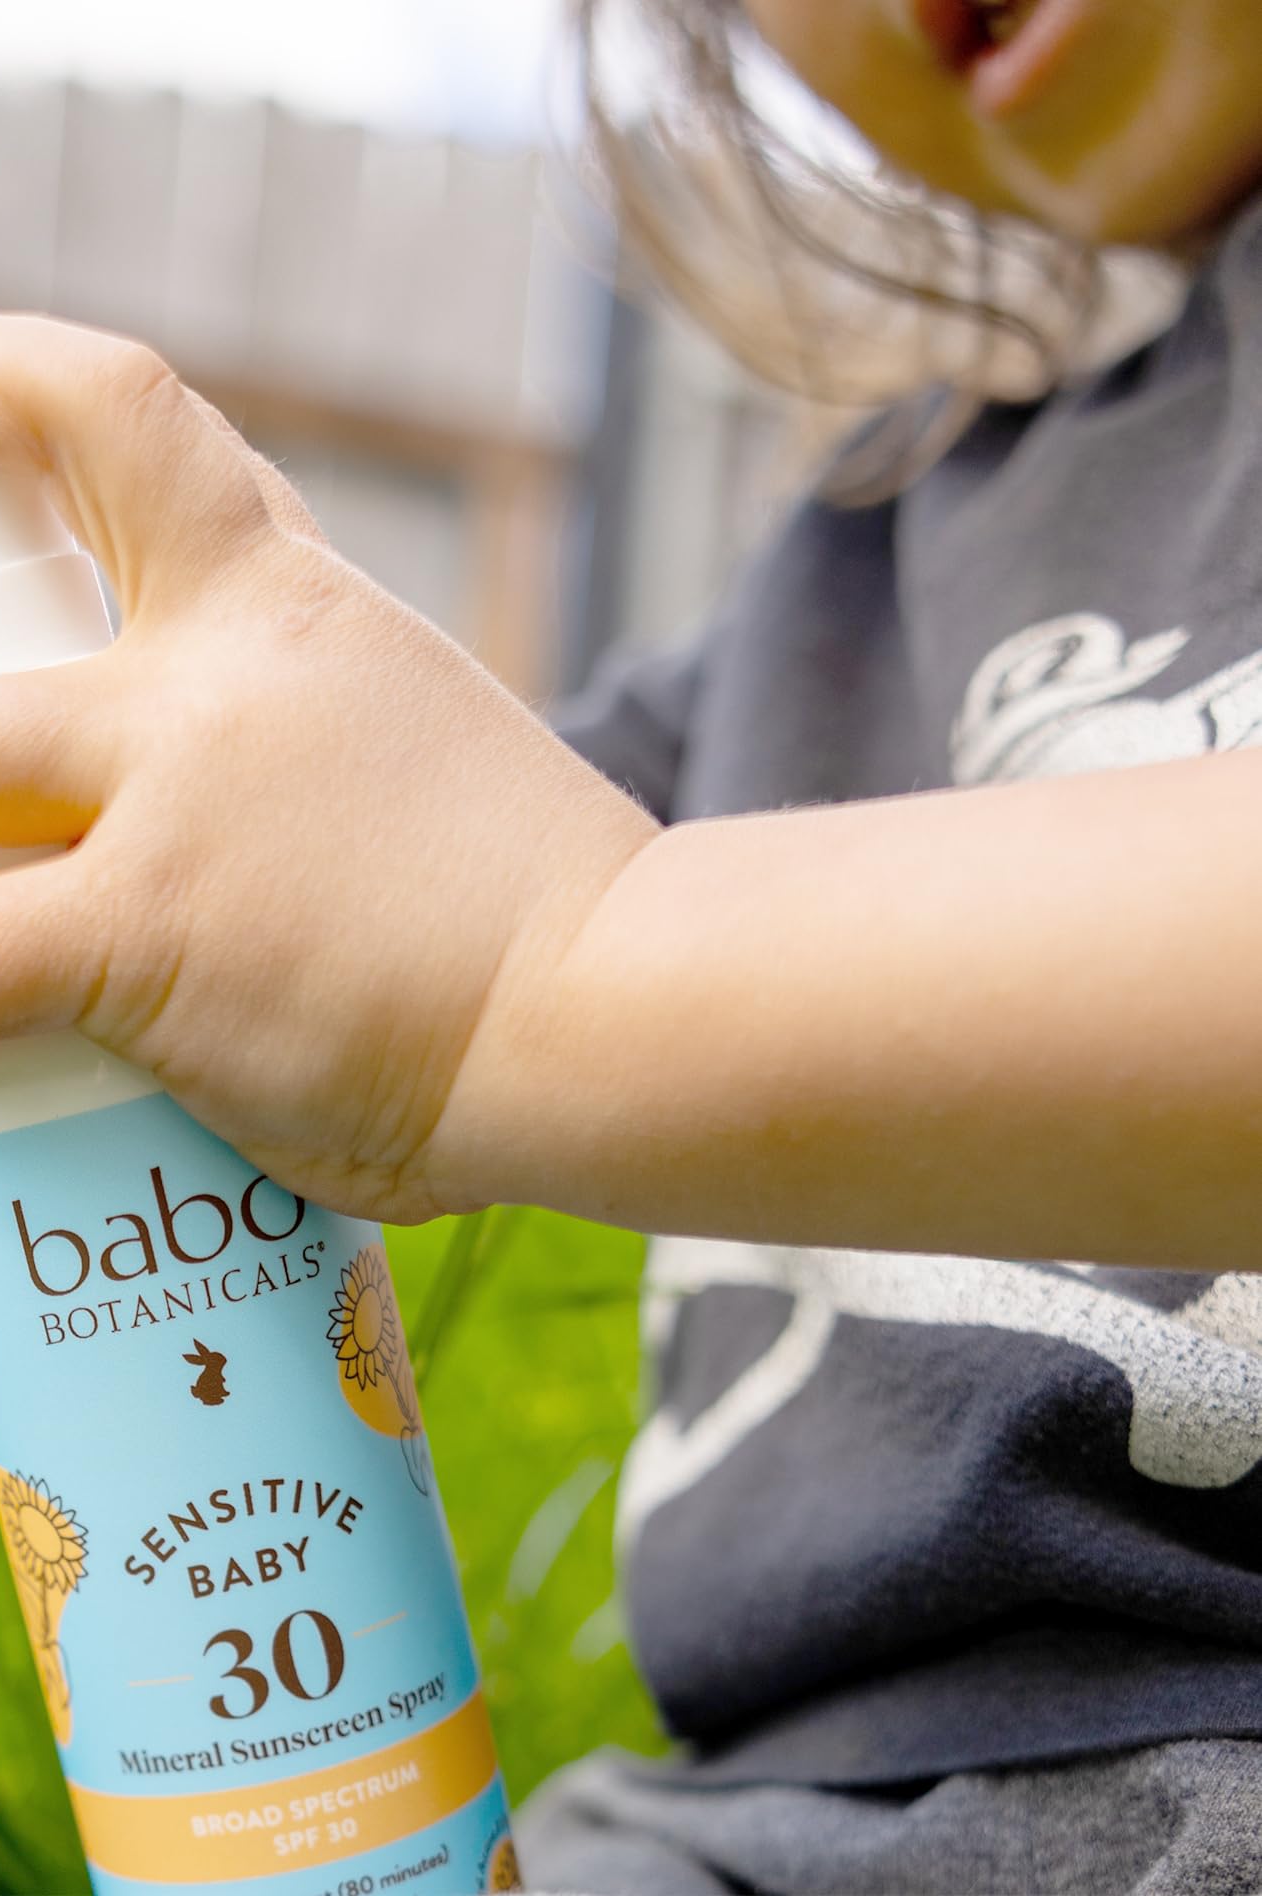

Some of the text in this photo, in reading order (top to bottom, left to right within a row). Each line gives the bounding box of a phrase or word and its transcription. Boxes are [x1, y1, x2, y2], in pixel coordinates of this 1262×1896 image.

[12, 1166, 305, 1296] babo
[124, 1478, 364, 1585] SENSITIVE
[187, 1536, 310, 1599] BABY
[202, 1609, 345, 1719] 30
[119, 1671, 446, 1776] Mineral Sunscreen Spray
[190, 1760, 420, 1838] BROAD SPECTRUM
[273, 1817, 358, 1857] SPF 30
[379, 1843, 450, 1889] minutes)
